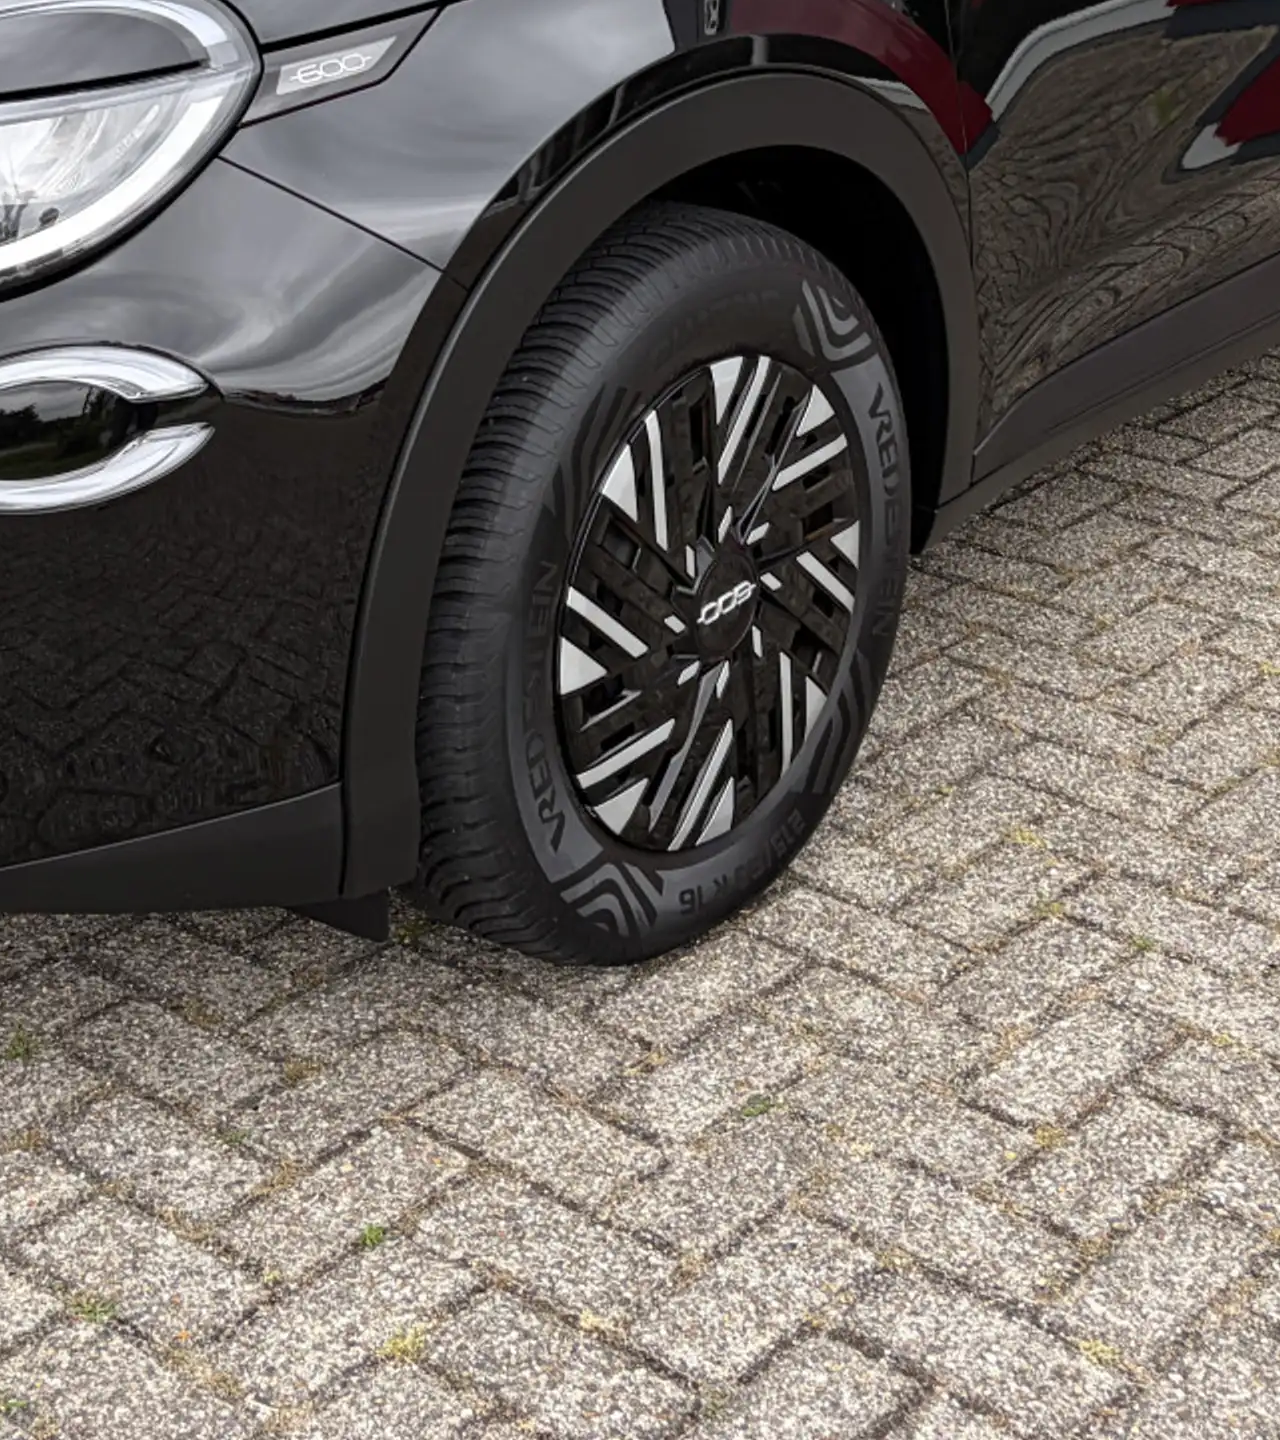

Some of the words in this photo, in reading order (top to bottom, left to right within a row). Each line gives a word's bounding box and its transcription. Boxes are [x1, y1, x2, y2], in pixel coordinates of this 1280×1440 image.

[289, 53, 373, 84] 600
[696, 580, 757, 626] 600
[679, 884, 704, 915] 16
